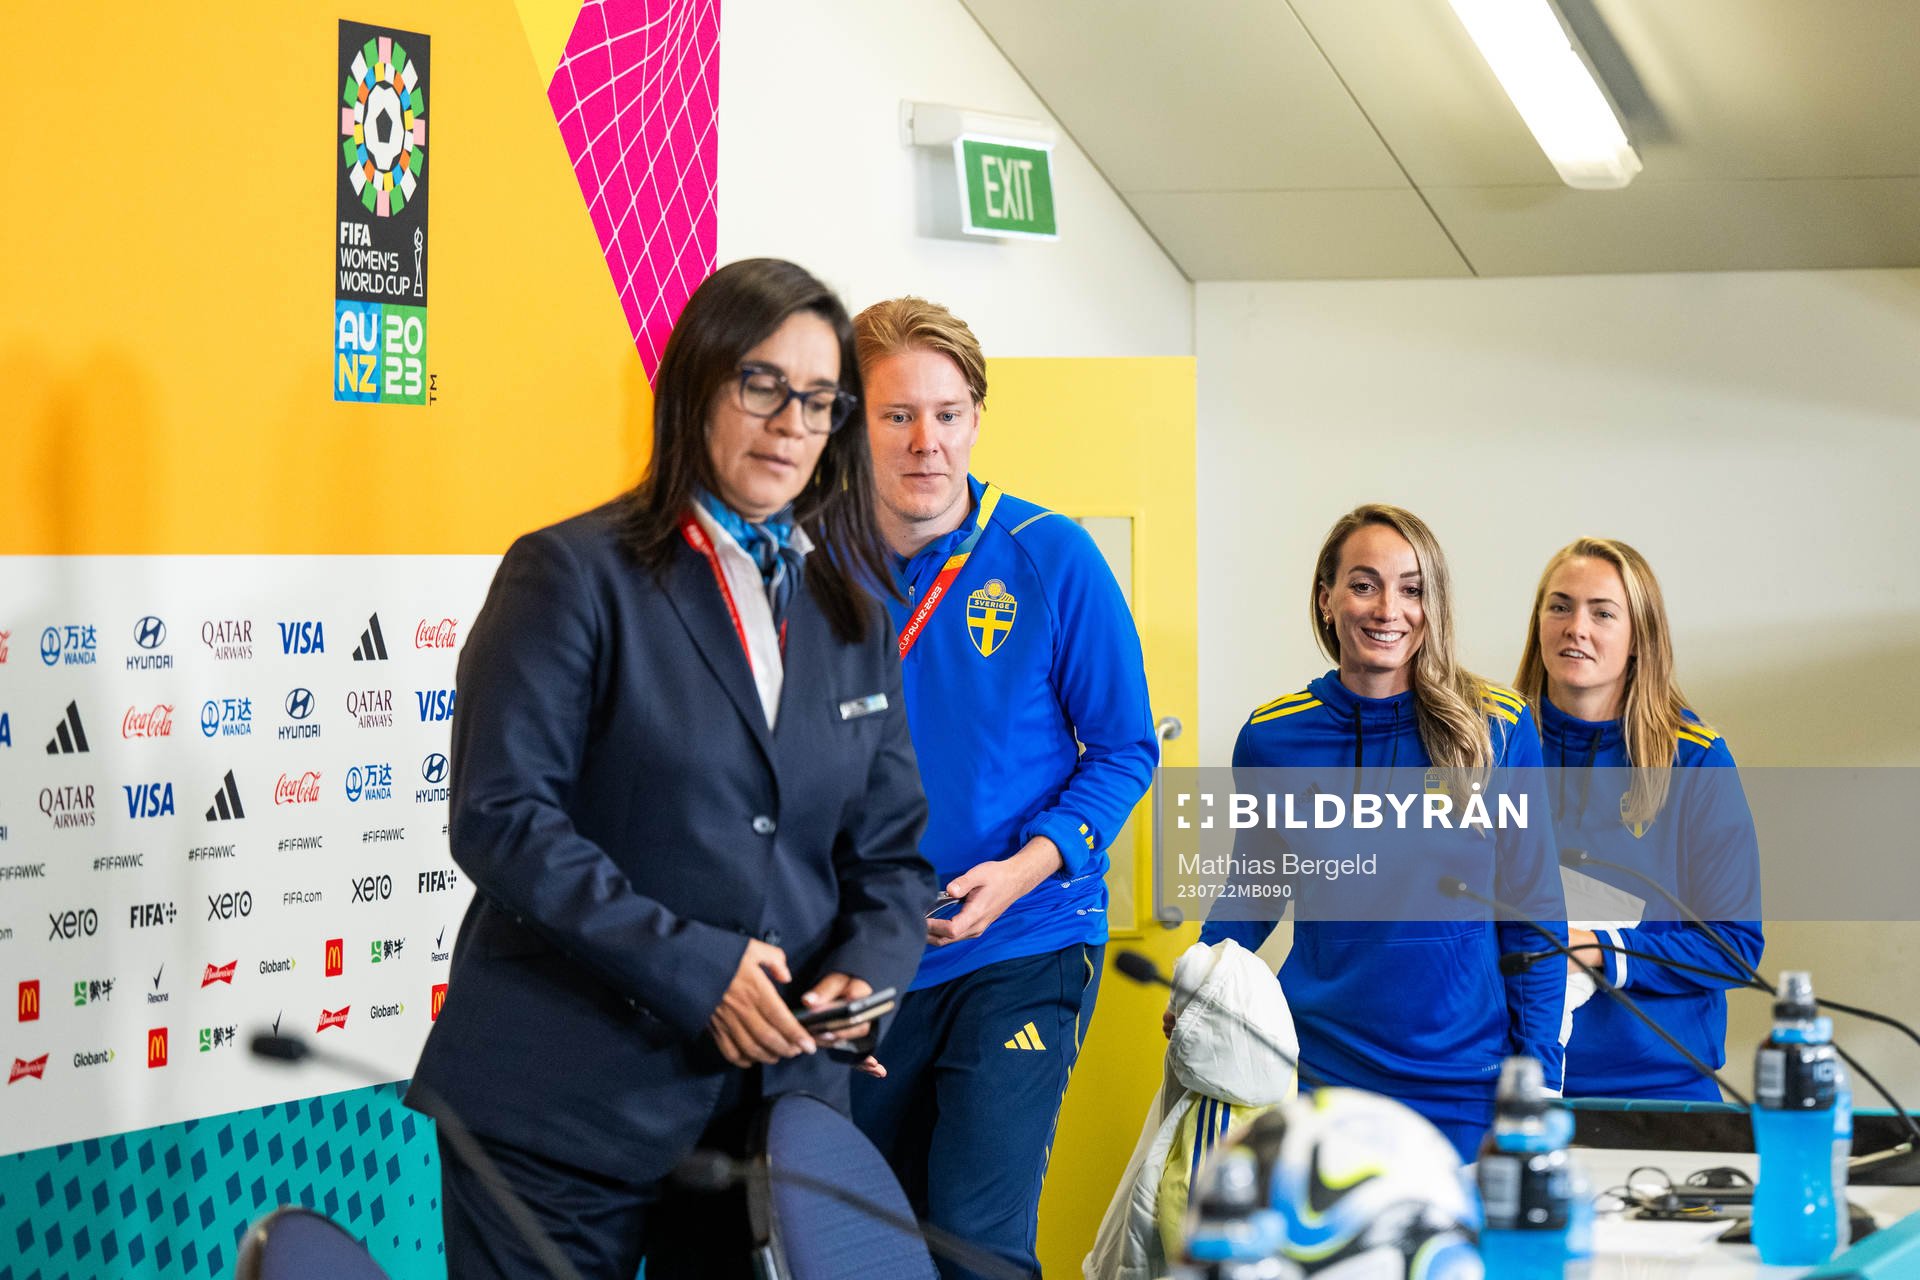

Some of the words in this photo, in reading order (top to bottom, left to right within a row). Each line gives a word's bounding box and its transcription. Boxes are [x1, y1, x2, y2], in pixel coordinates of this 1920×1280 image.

[981, 155, 1034, 221] EXIT
[340, 221, 372, 247] FIFA
[340, 248, 399, 273] WOMEN'S
[340, 270, 384, 294] WORLD
[386, 276, 411, 296] CUP
[338, 310, 378, 352] AU
[385, 314, 424, 355] 20
[338, 352, 378, 394] NZ
[385, 355, 423, 396] 23
[974, 599, 1010, 610] SVERIGE
[64, 625, 96, 650] 万达
[202, 620, 252, 649] QATAR
[277, 621, 324, 654] VISA
[64, 651, 96, 665] WANDA
[127, 655, 173, 669] HYUNDAI
[216, 646, 252, 659] AIRWAYS
[222, 698, 251, 721] 万达
[347, 690, 392, 717] QATAR
[222, 723, 251, 736] WANDA
[359, 714, 392, 728] AIRWAYS
[279, 724, 320, 739] HYUNDAI
[365, 763, 391, 786] 万达
[39, 785, 94, 818] QATAR
[123, 783, 174, 819] VISA
[365, 785, 391, 800] WANDA
[416, 788, 450, 803] HYUNDA
[54, 812, 95, 828] AIRWAYS
[278, 836, 322, 851] #FIFAWWC
[363, 828, 404, 842] #FIFAWWC
[93, 854, 143, 871] #FIFAWWC
[188, 845, 235, 861] #FIFAWWC
[0, 863, 45, 880] FIFAWWC
[284, 891, 322, 904] FIFA.com
[352, 875, 392, 903] xero
[208, 891, 252, 921] xero
[49, 908, 98, 941] xero
[260, 959, 290, 974] Globant
[371, 1004, 399, 1019] Globant
[74, 1051, 109, 1068] Globant
